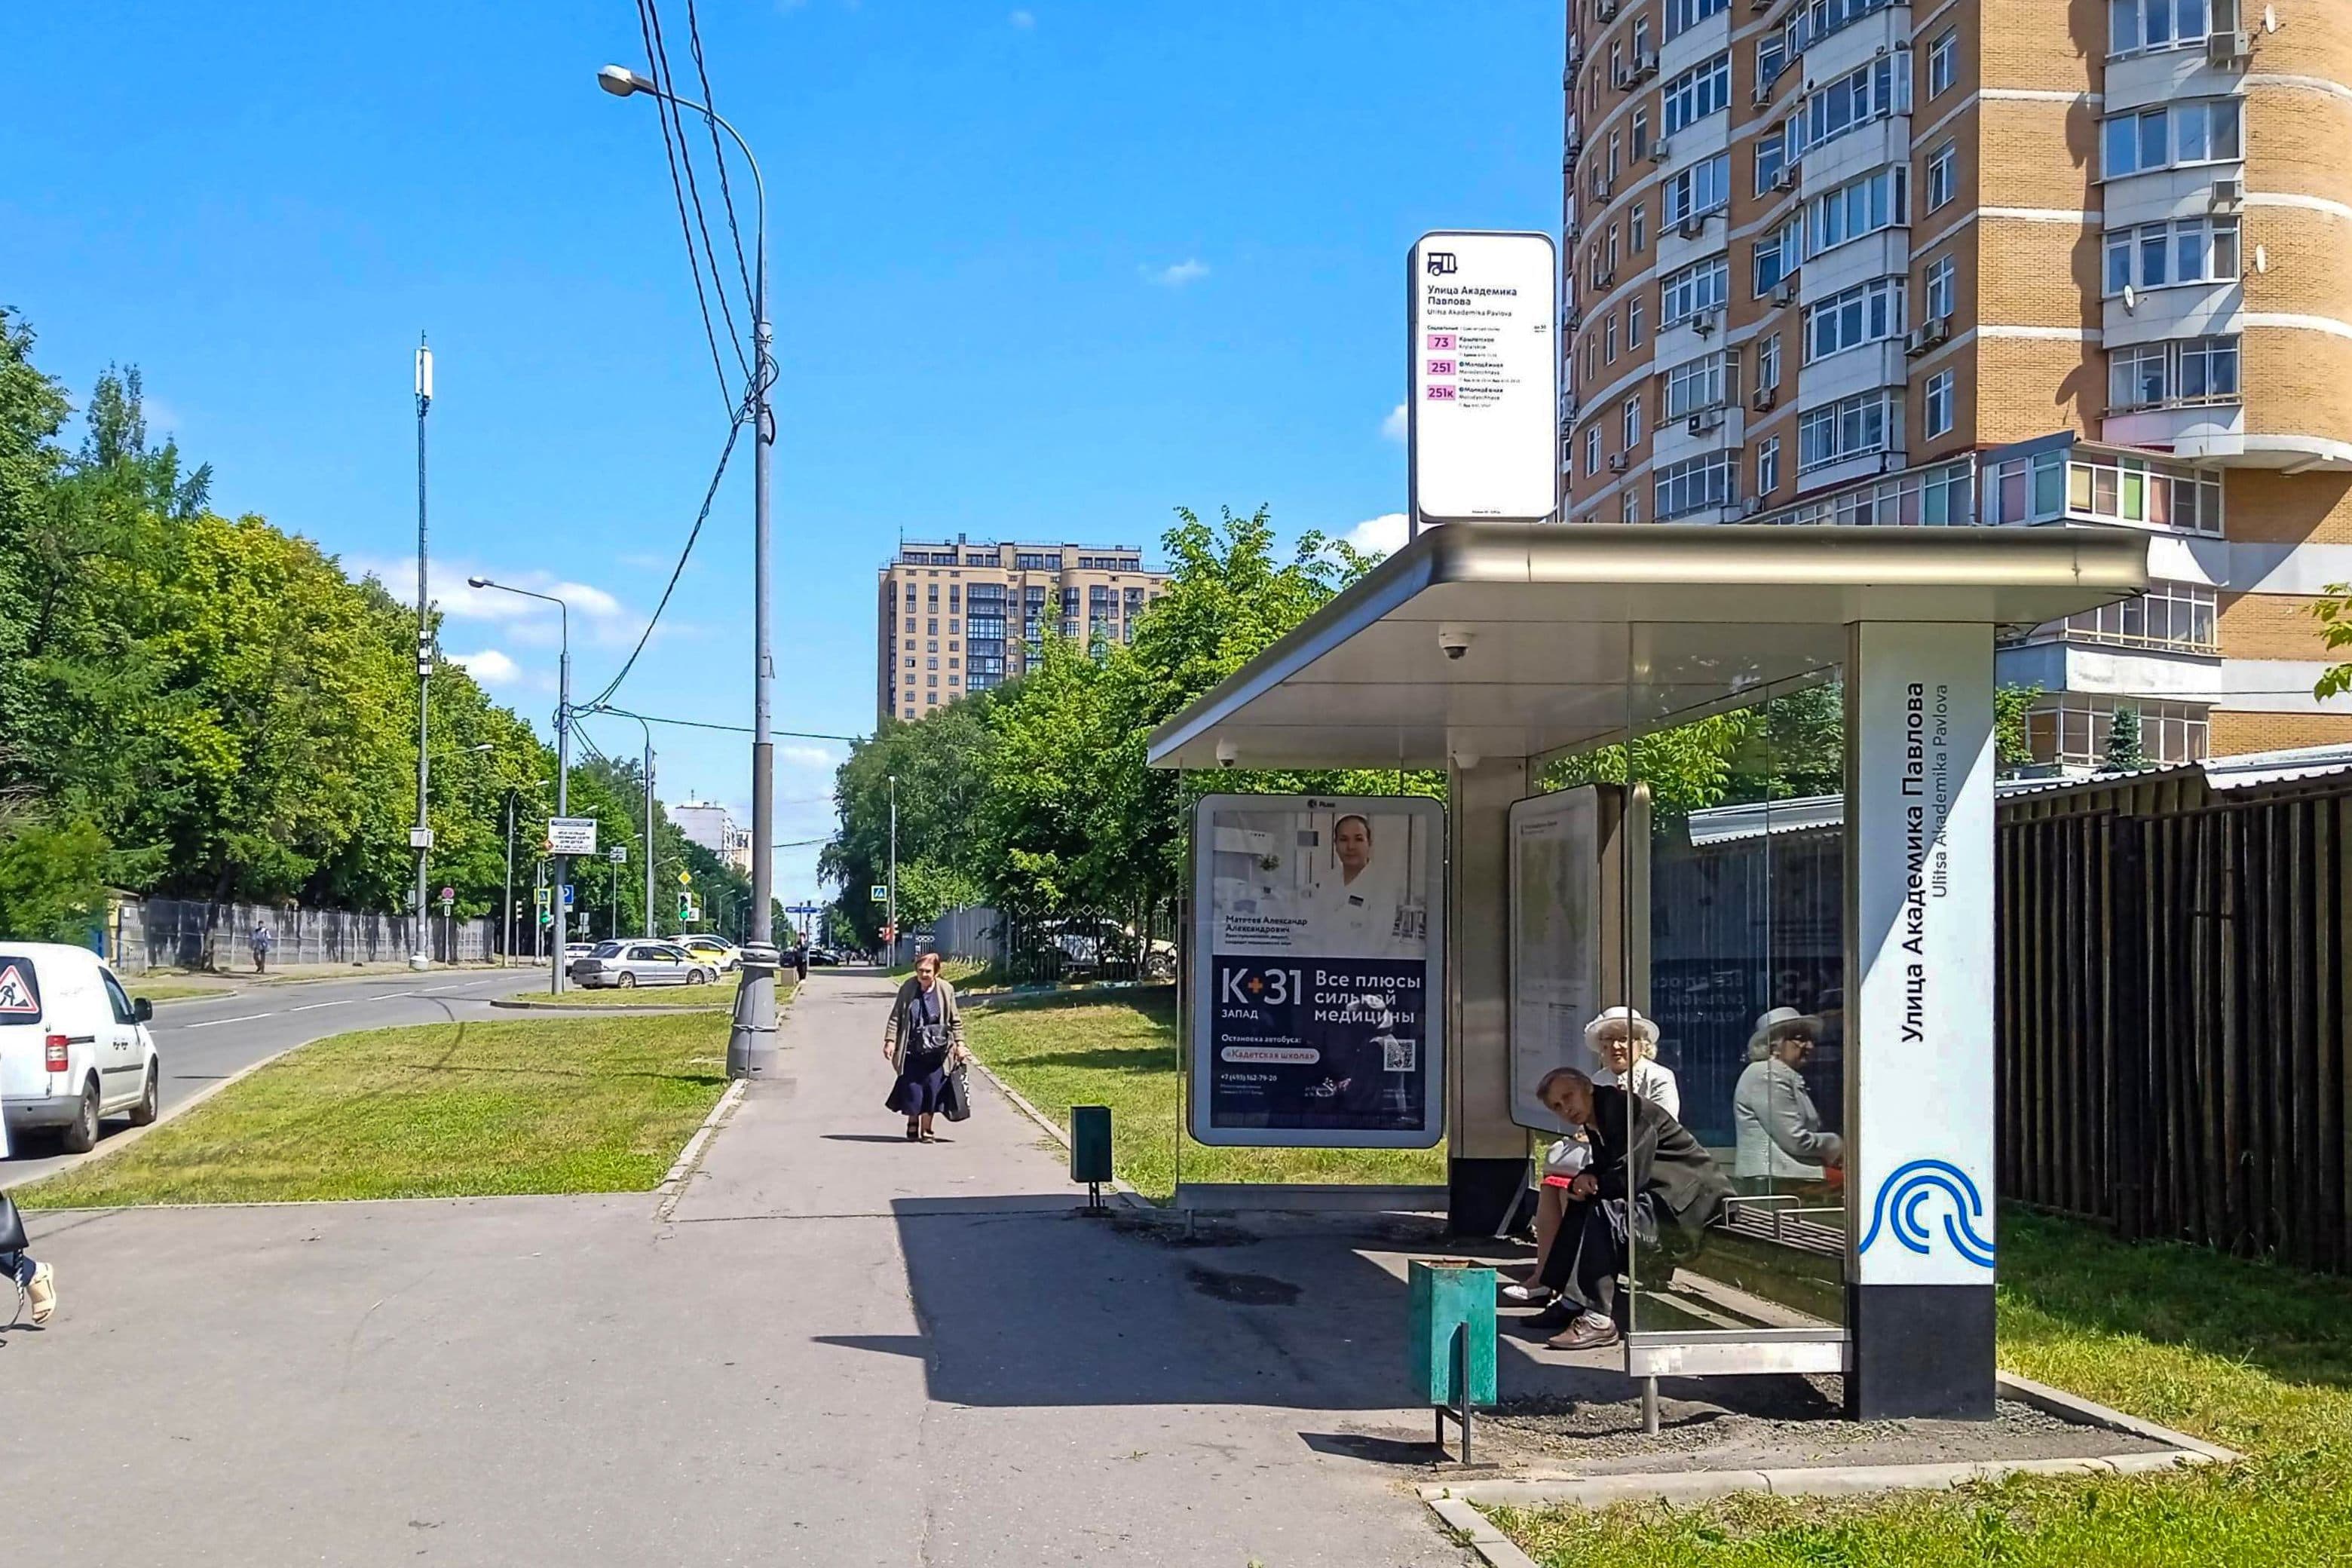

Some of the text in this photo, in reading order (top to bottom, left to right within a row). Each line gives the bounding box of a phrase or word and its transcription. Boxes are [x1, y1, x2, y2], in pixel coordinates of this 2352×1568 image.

[1427, 285, 1517, 297] Улица Академика
[1428, 296, 1472, 305] Павлова
[1434, 337, 1449, 348] 73
[1432, 362, 1451, 372] 251
[1429, 387, 1454, 398] 251к
[1931, 684, 1948, 898] Ulitsa Akademika Pavlova
[1901, 682, 1927, 1043] Улица Академика Павлова
[1263, 916, 1308, 926] Александр
[1226, 924, 1290, 933] Александрович
[1315, 969, 1420, 988] Все плюсы
[1221, 1009, 1259, 1019] ЗАПАД
[1315, 1009, 1414, 1024] медицины
[1221, 1034, 1302, 1045] Остановка автобуса:
